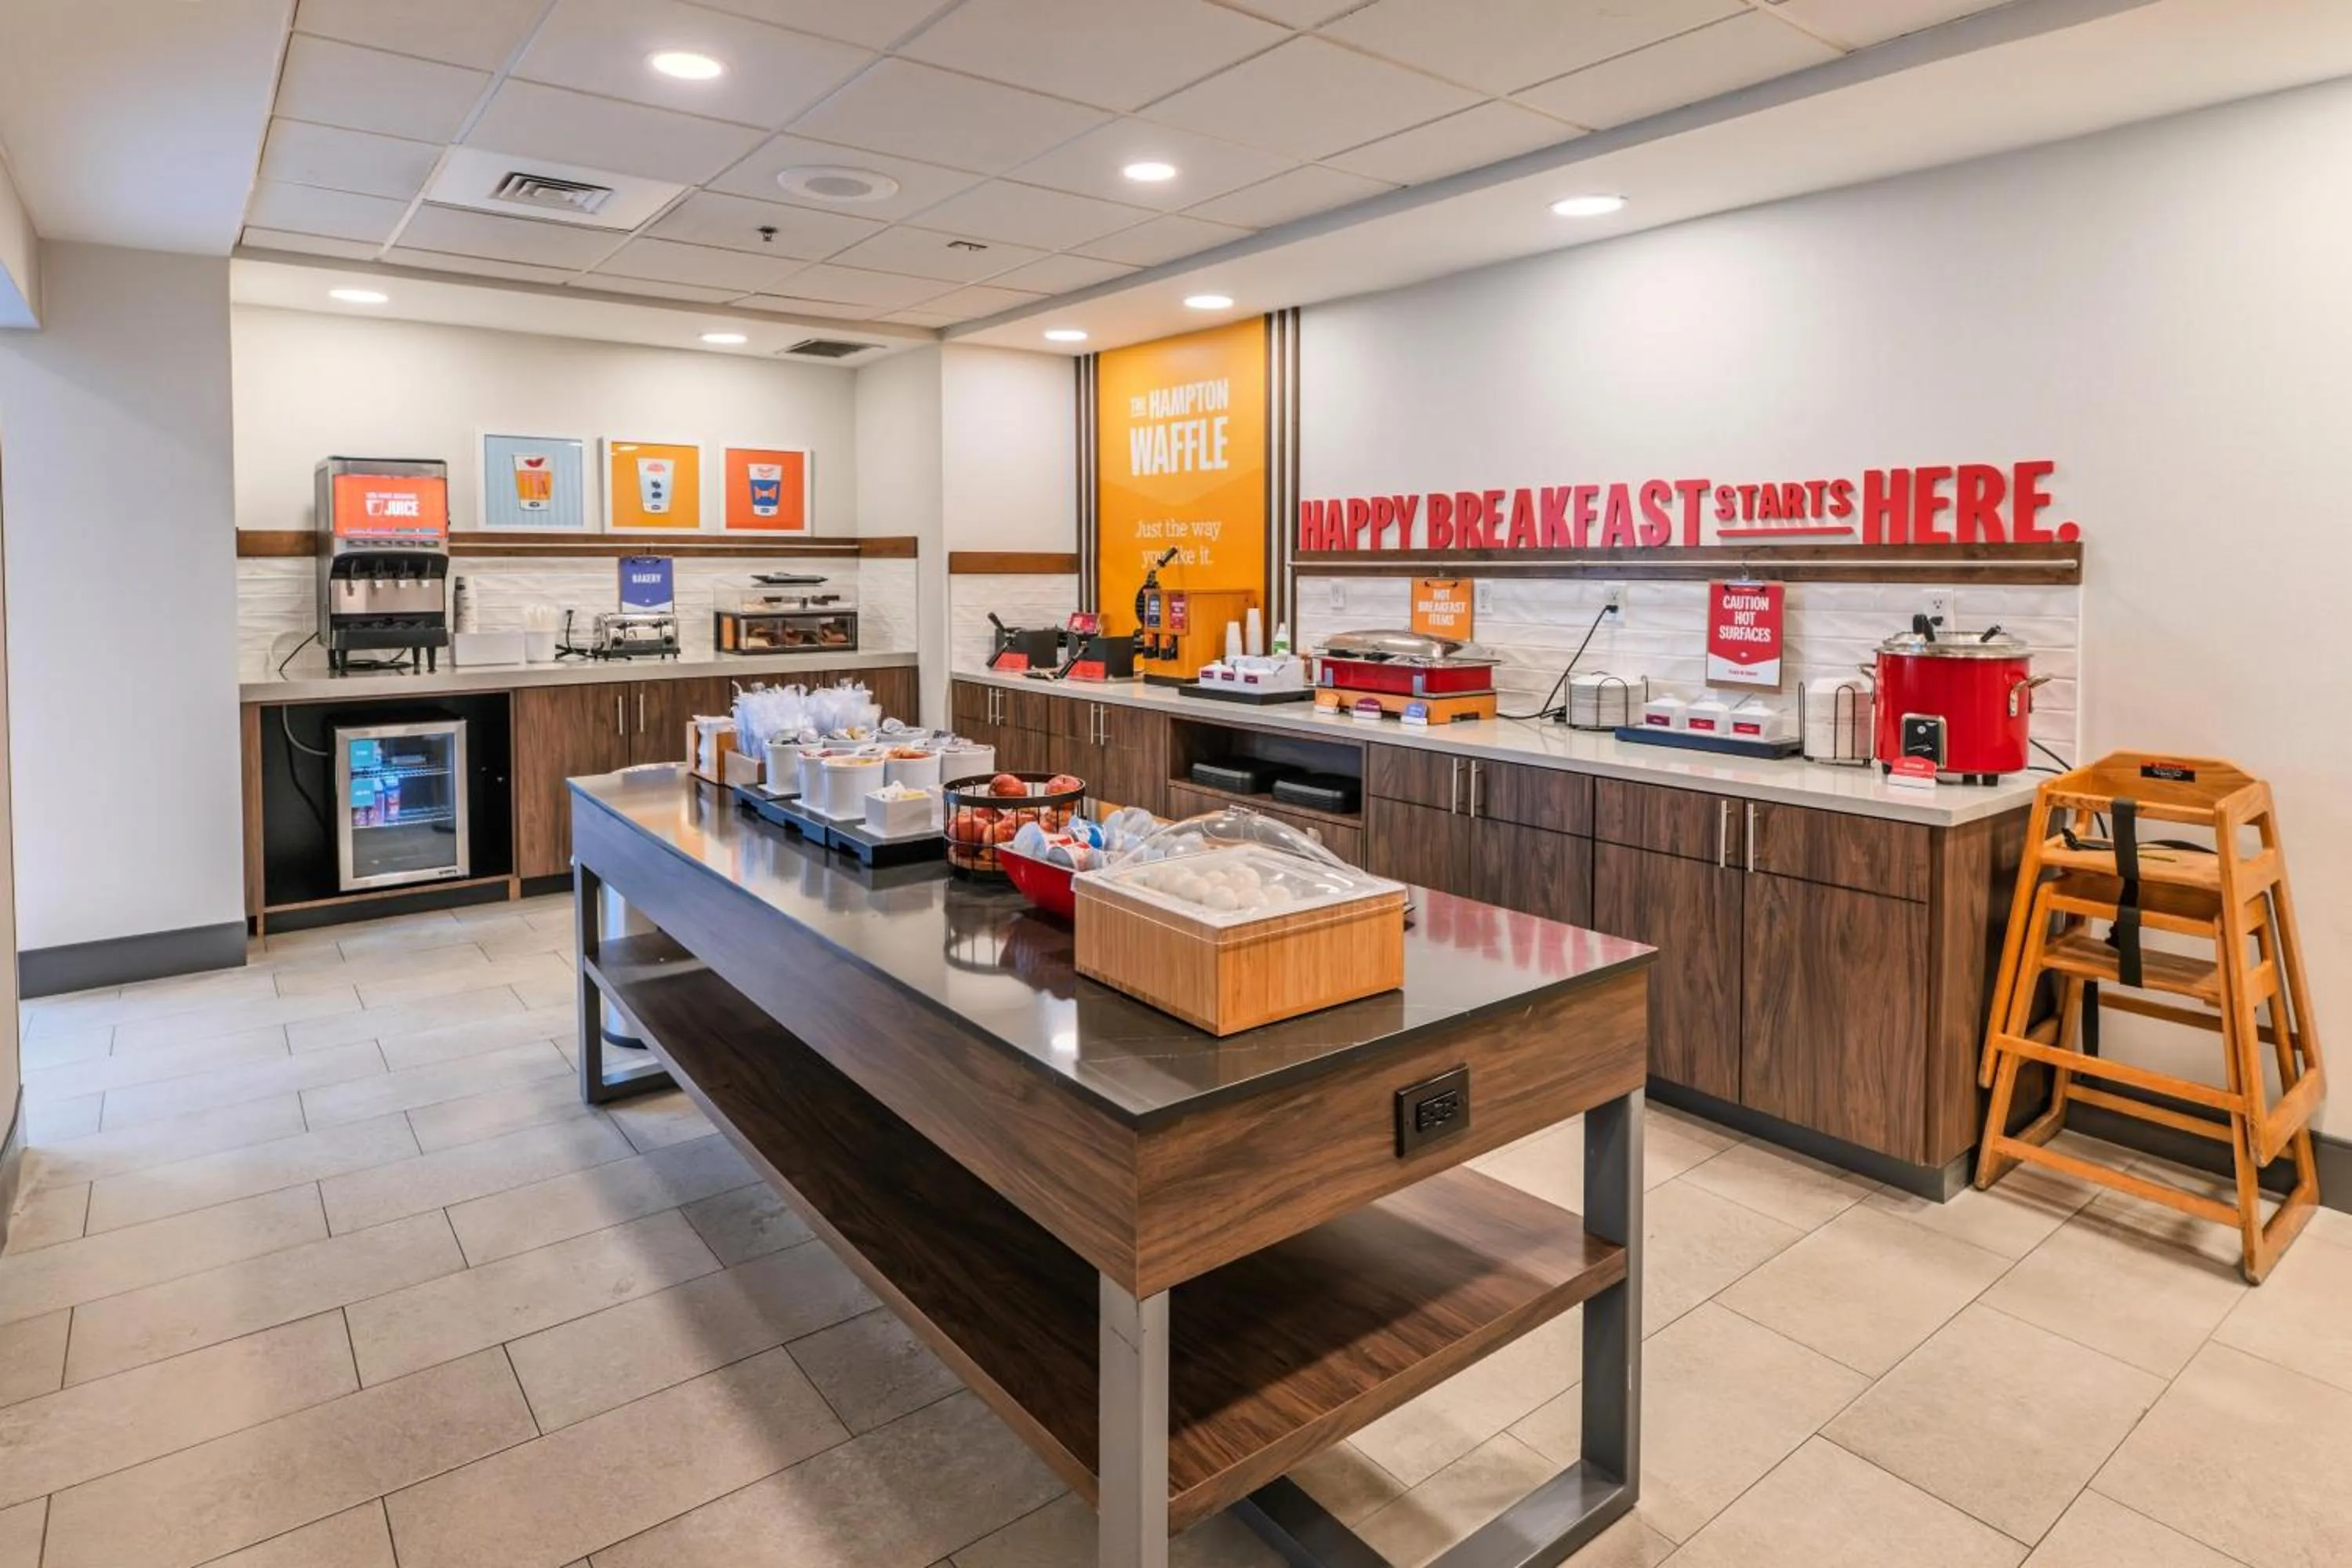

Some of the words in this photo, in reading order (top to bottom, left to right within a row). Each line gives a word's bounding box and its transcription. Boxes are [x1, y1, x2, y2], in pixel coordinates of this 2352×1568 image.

[1149, 378, 1229, 419] HAMPTON
[1130, 416, 1229, 477] WAFFLE
[383, 500, 419, 517] JUICE
[1301, 495, 1419, 551] HAPPY
[1427, 479, 1711, 550] BREAKFAST
[1715, 479, 1854, 521] STARTS
[1863, 460, 2080, 545] HERE.
[1135, 520, 1163, 539] Just
[1164, 517, 1189, 537] the
[1190, 521, 1221, 542] way
[631, 573, 662, 584] BAKERY
[1432, 589, 1450, 601] HOT
[1722, 595, 1769, 611] CAUTION
[1417, 601, 1466, 613] BREAKFAST
[1734, 611, 1756, 626] HOT
[1718, 625, 1771, 643] SURFACES
